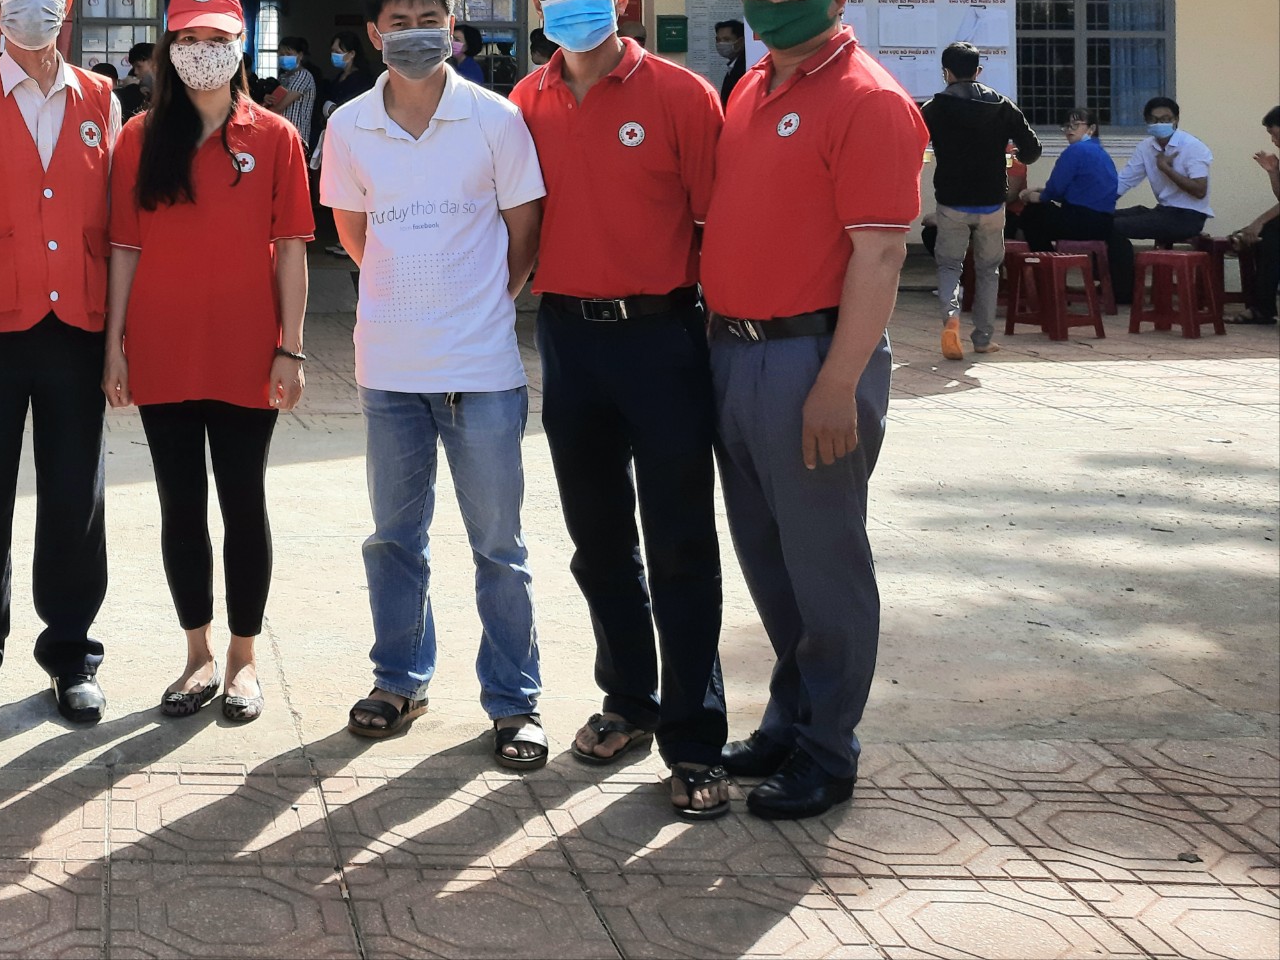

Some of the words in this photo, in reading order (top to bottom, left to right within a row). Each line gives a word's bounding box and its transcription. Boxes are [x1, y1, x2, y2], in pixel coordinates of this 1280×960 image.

[370, 211, 385, 225] Tư
[387, 206, 409, 222] duy
[411, 200, 436, 216] thời
[439, 200, 460, 216] đại
